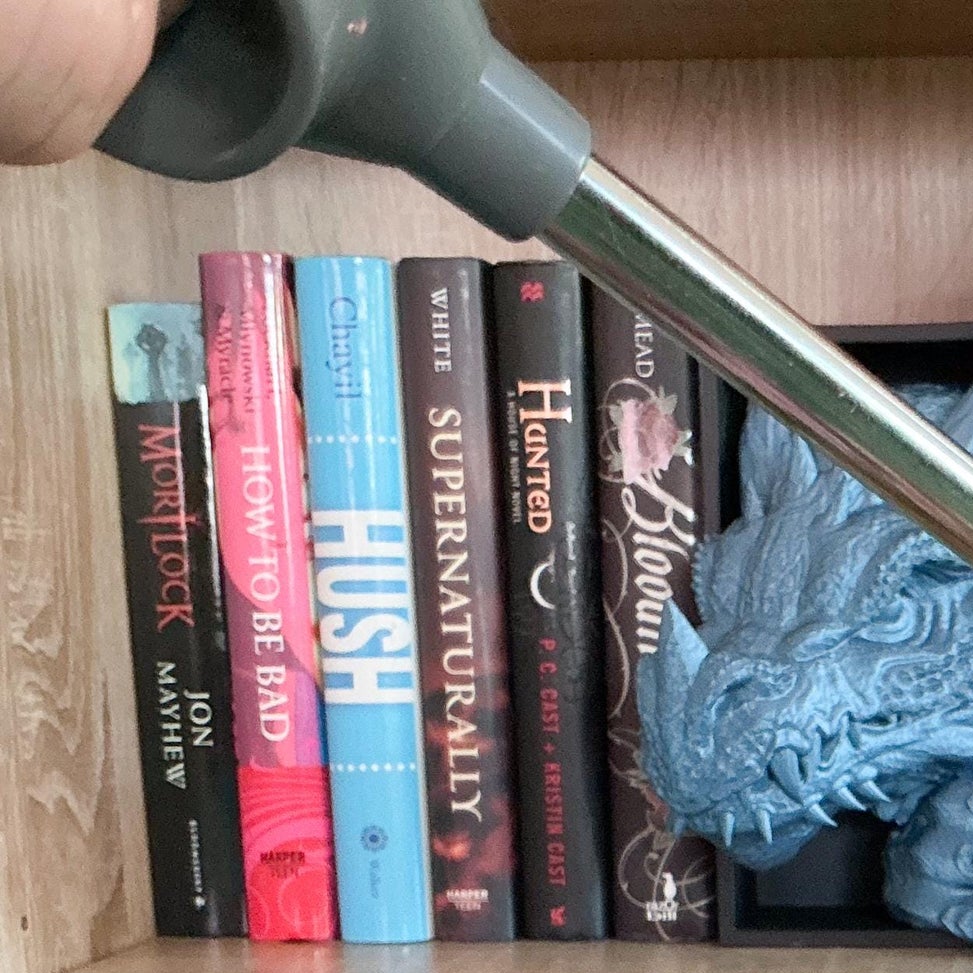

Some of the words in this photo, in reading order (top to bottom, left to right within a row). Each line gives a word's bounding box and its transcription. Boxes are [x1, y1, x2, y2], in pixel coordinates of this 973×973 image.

[430, 287, 452, 374] WHITE
[240, 445, 277, 544] HOW
[517, 378, 573, 534] HUNTED
[138, 423, 199, 633] MORTLOCK
[248, 552, 281, 602] TO
[309, 509, 416, 705] HUSH
[428, 407, 482, 823] SUPERNATURALLY
[252, 611, 285, 655] BE
[156, 661, 187, 790] MAYHEW
[184, 689, 214, 747] JON
[255, 665, 291, 743] BAD
[540, 688, 561, 734] CAST
[544, 762, 564, 835] KRISTIN
[547, 841, 566, 887] CAST
